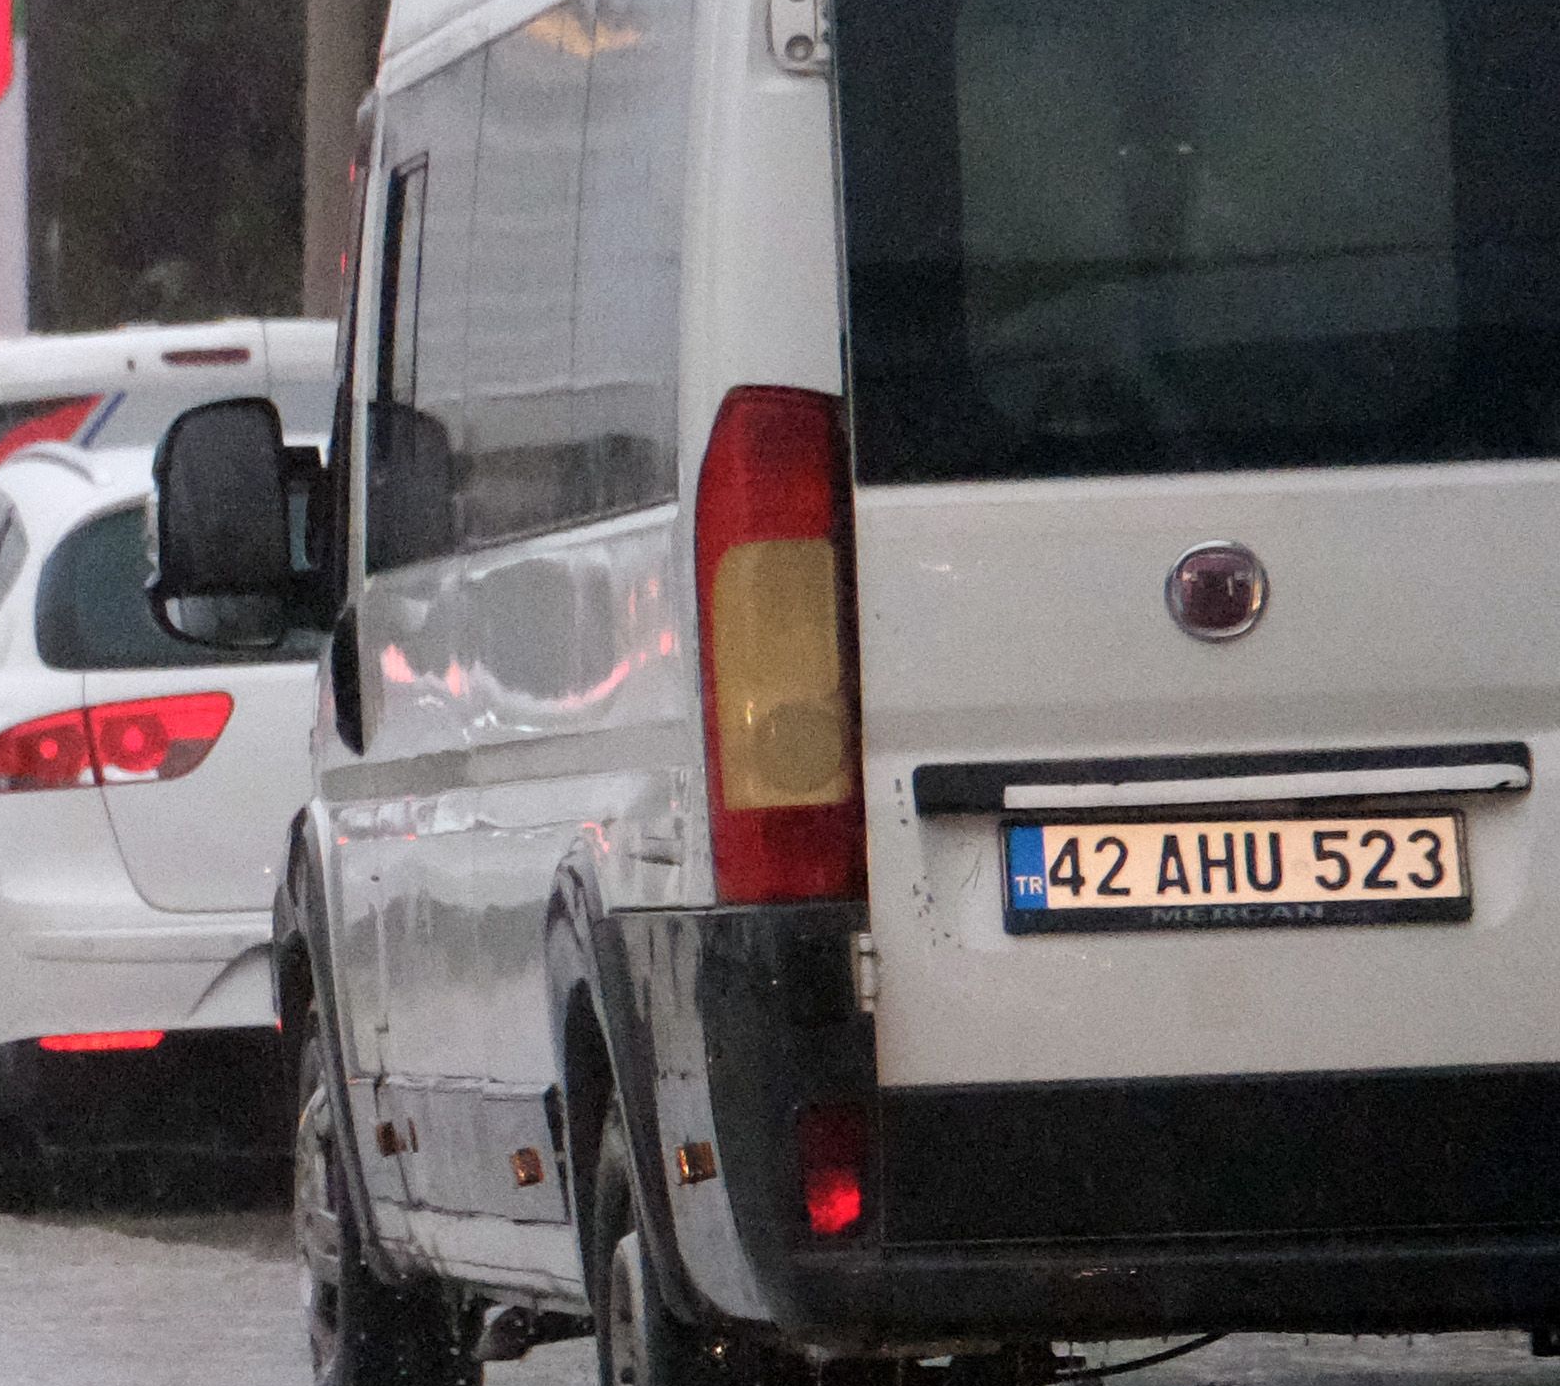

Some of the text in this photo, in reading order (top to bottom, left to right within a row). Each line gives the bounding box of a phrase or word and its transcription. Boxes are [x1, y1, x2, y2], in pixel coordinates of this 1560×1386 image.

[1015, 827, 1446, 898] TR 42 AHU 523
[1150, 902, 1325, 925] MERCAN
